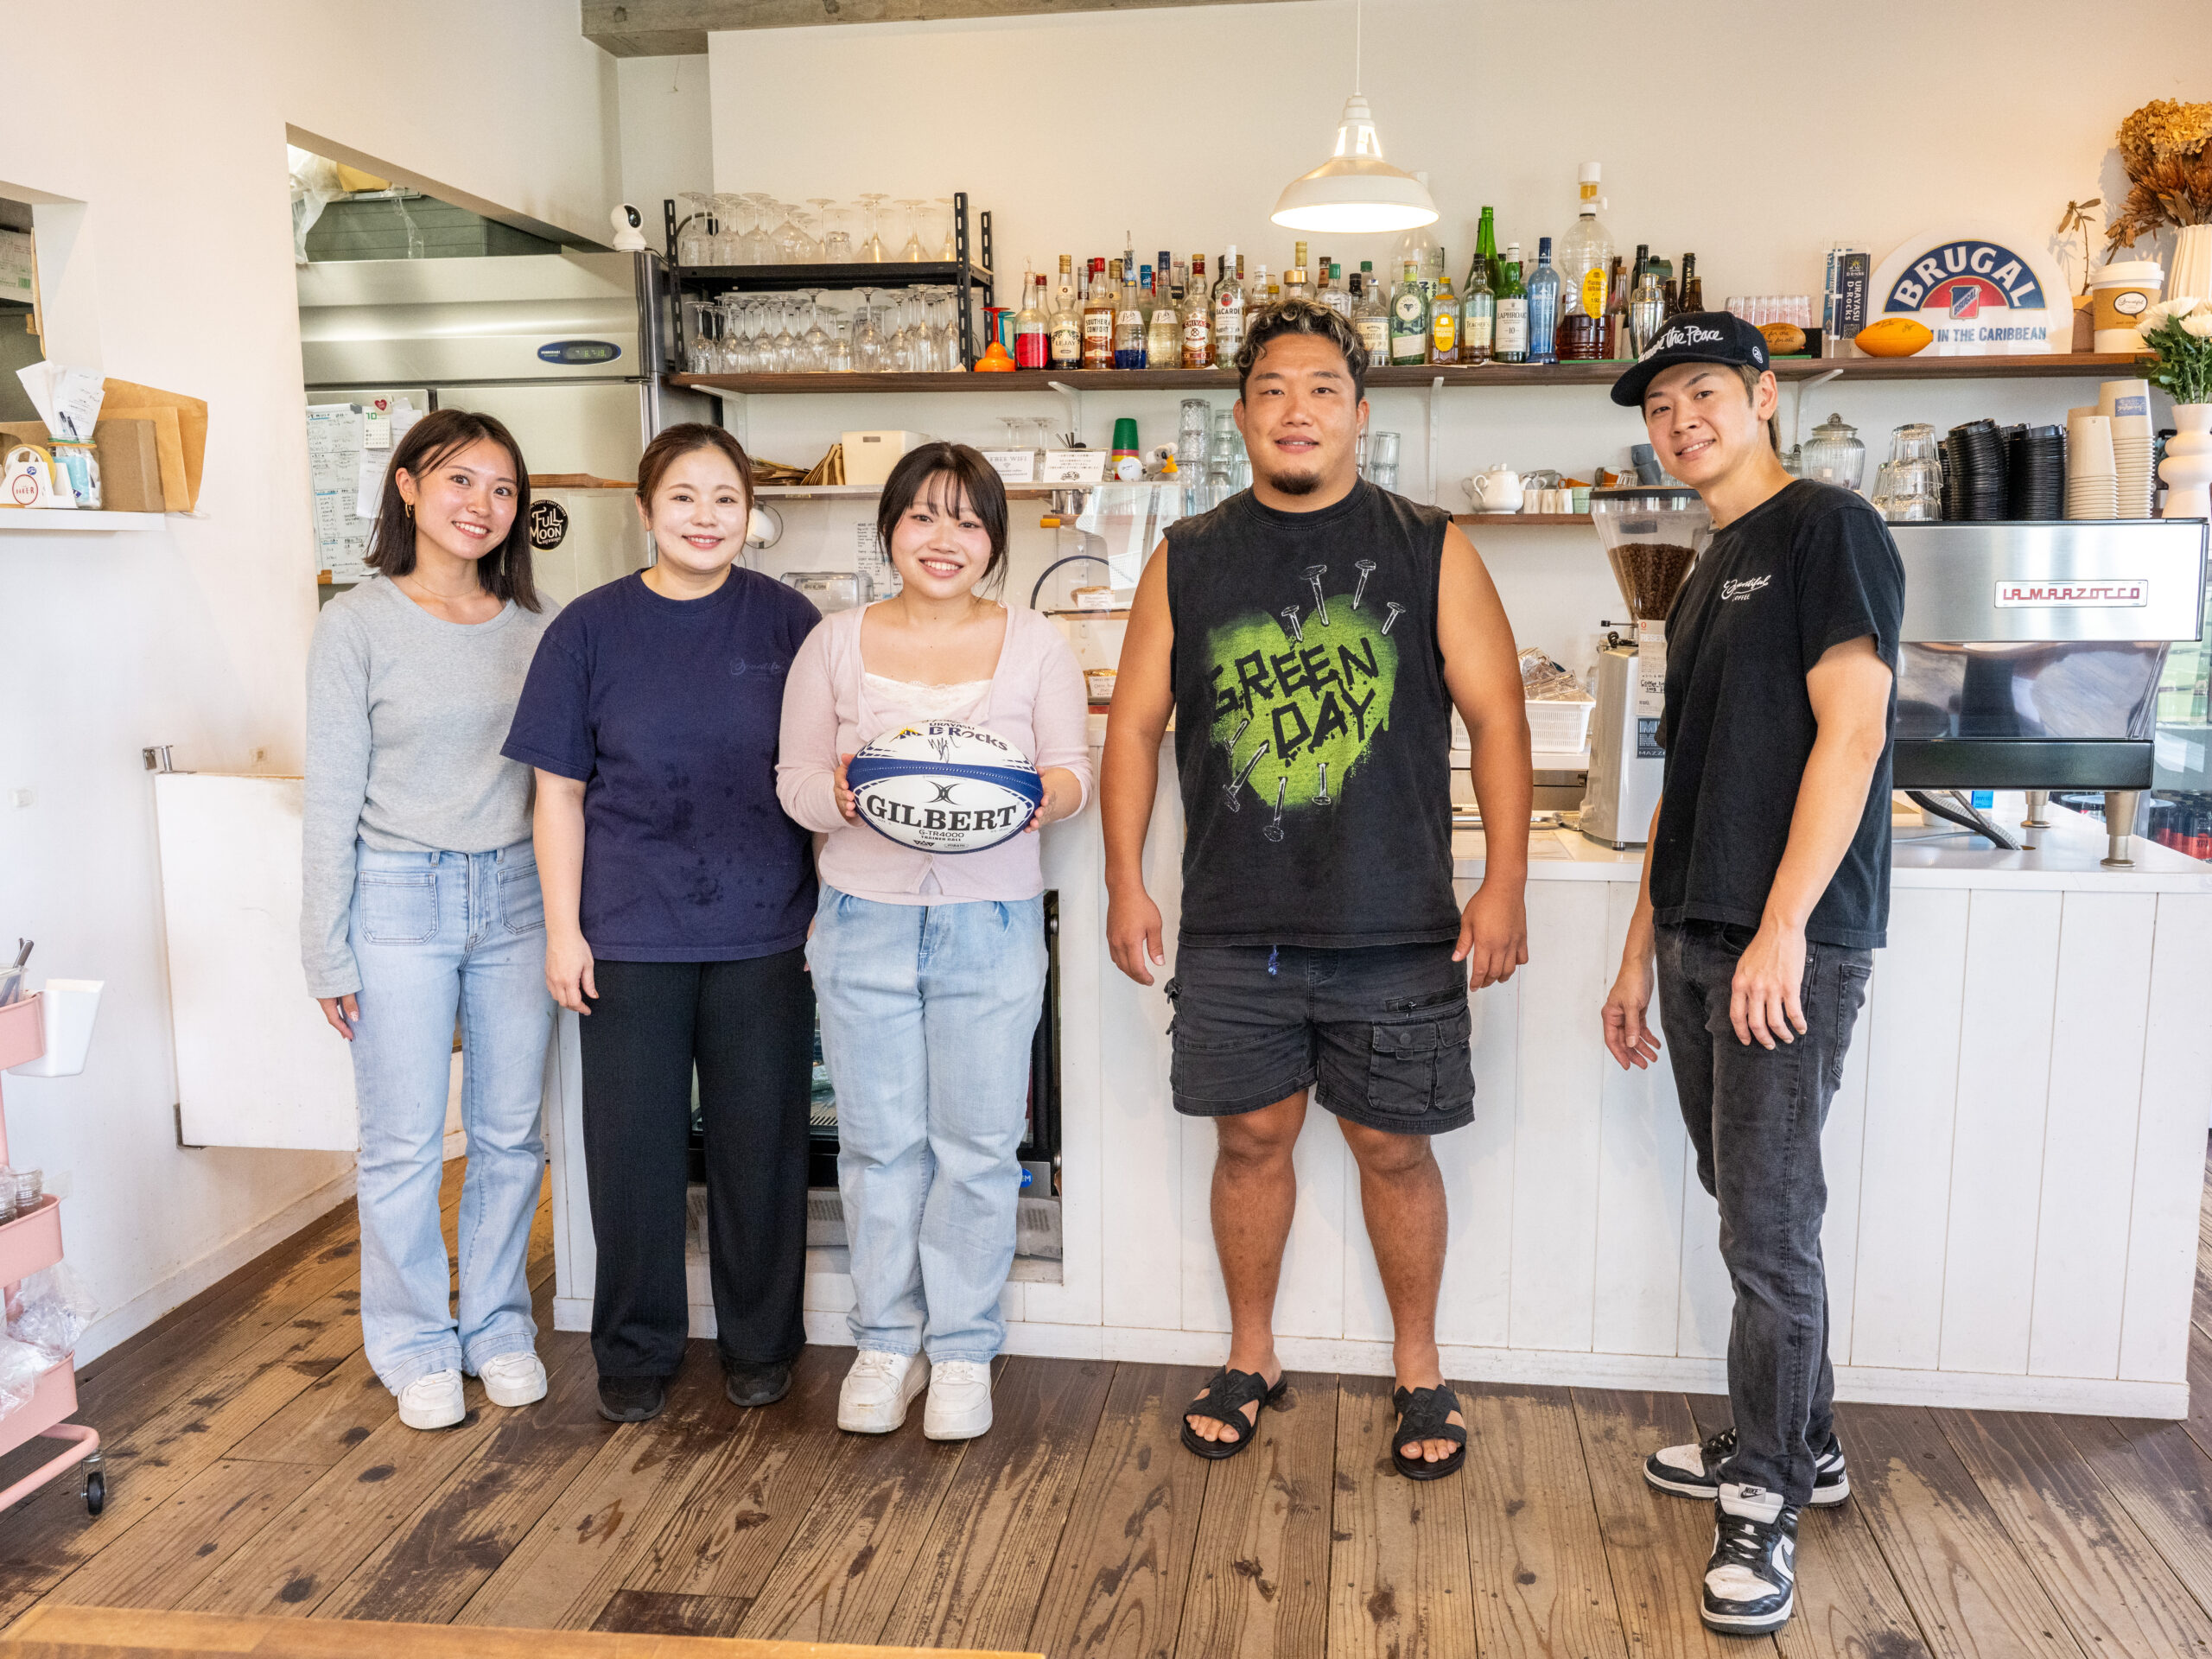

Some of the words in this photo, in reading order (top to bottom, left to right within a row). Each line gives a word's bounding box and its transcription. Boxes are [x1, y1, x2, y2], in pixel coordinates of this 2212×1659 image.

[1893, 245, 2036, 308] BRUGAL
[1853, 281, 1862, 321] URAYASU
[1954, 288, 1976, 315] BRUGAL
[1666, 327, 1687, 348] the
[1685, 326, 1724, 346] Peace
[1937, 330, 1949, 342] IN
[1954, 328, 1975, 341] THE
[1979, 327, 2046, 341] CARIBBEAN
[530, 525, 563, 543] MOON
[1207, 637, 1380, 719] GREEN
[1271, 688, 1376, 760] DAY
[866, 795, 1017, 831] GILBERT
[918, 830, 965, 838] G-TR4000
